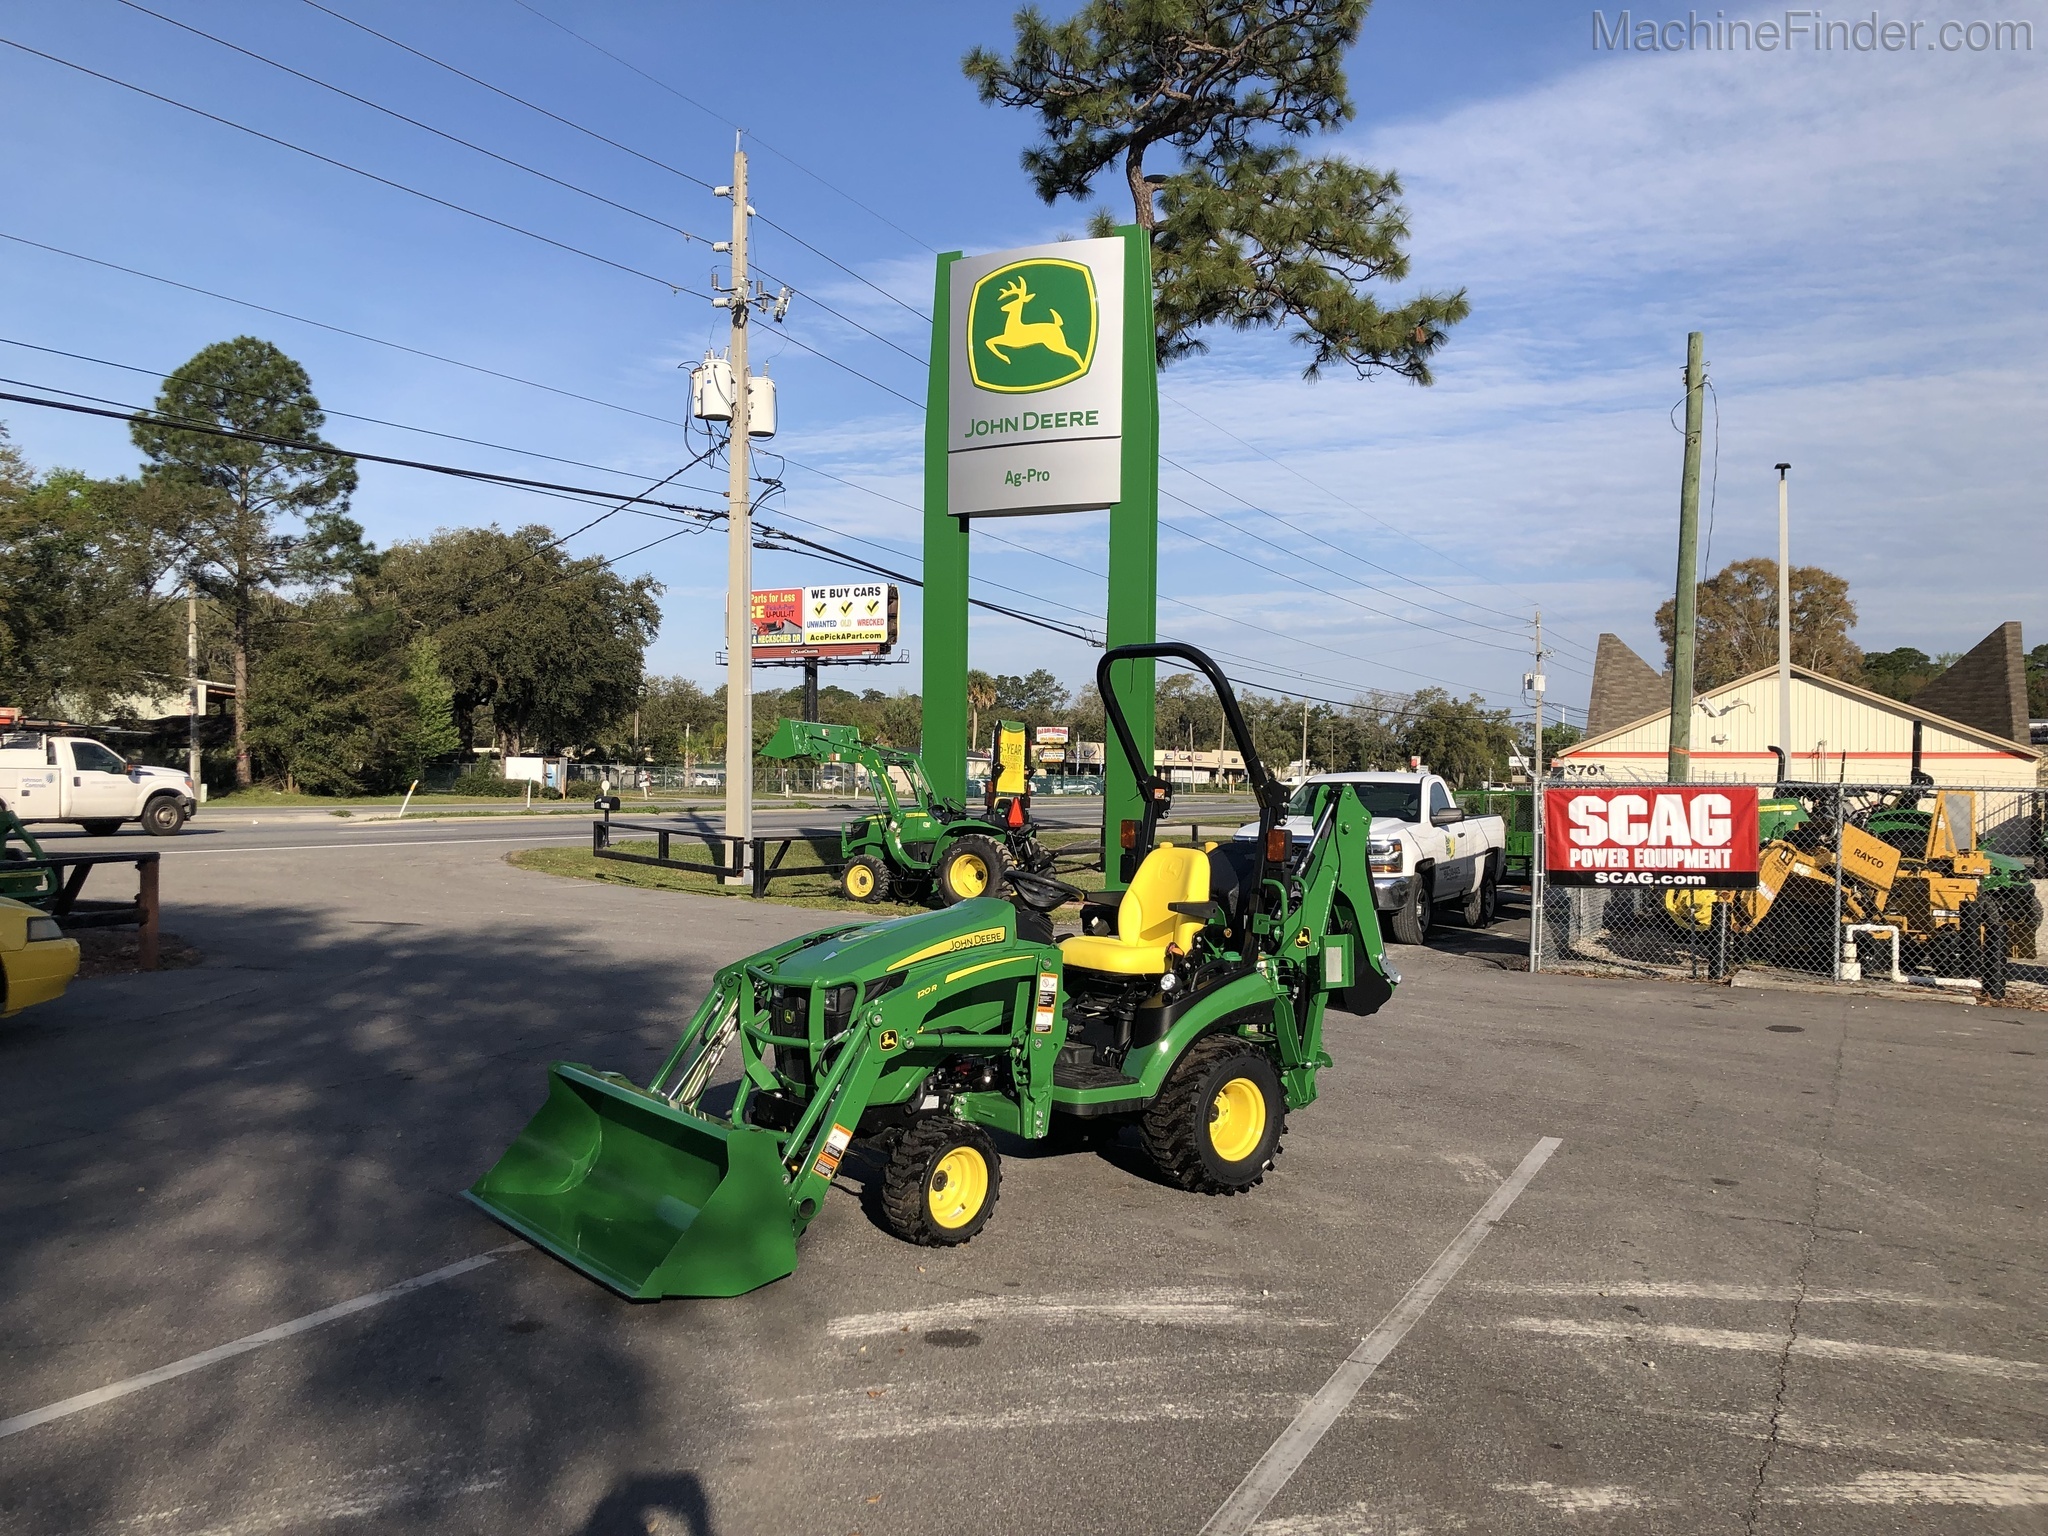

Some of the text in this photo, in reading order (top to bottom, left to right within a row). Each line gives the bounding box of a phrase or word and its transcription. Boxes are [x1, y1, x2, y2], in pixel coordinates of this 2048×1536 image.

[964, 410, 1099, 438] JOHN DEERE
[1004, 468, 1050, 487] Ag-Pro
[769, 593, 780, 603] for
[781, 592, 796, 602] Less
[811, 586, 881, 599] WE BUY CARS
[766, 610, 795, 618] U-PULL-IT
[807, 620, 837, 629] UNWANTED
[840, 619, 852, 628] OLD
[857, 618, 885, 627] WRECKED
[793, 633, 801, 642] DR
[809, 632, 882, 641] AcePickAPart.com
[1568, 793, 1732, 846] SCAG
[1569, 847, 1733, 870] POWER EQUIPMENT
[1853, 848, 1884, 869] RAYCO
[1594, 872, 1707, 885] SCAG.com
[950, 932, 1002, 951] JOHN DEERE
